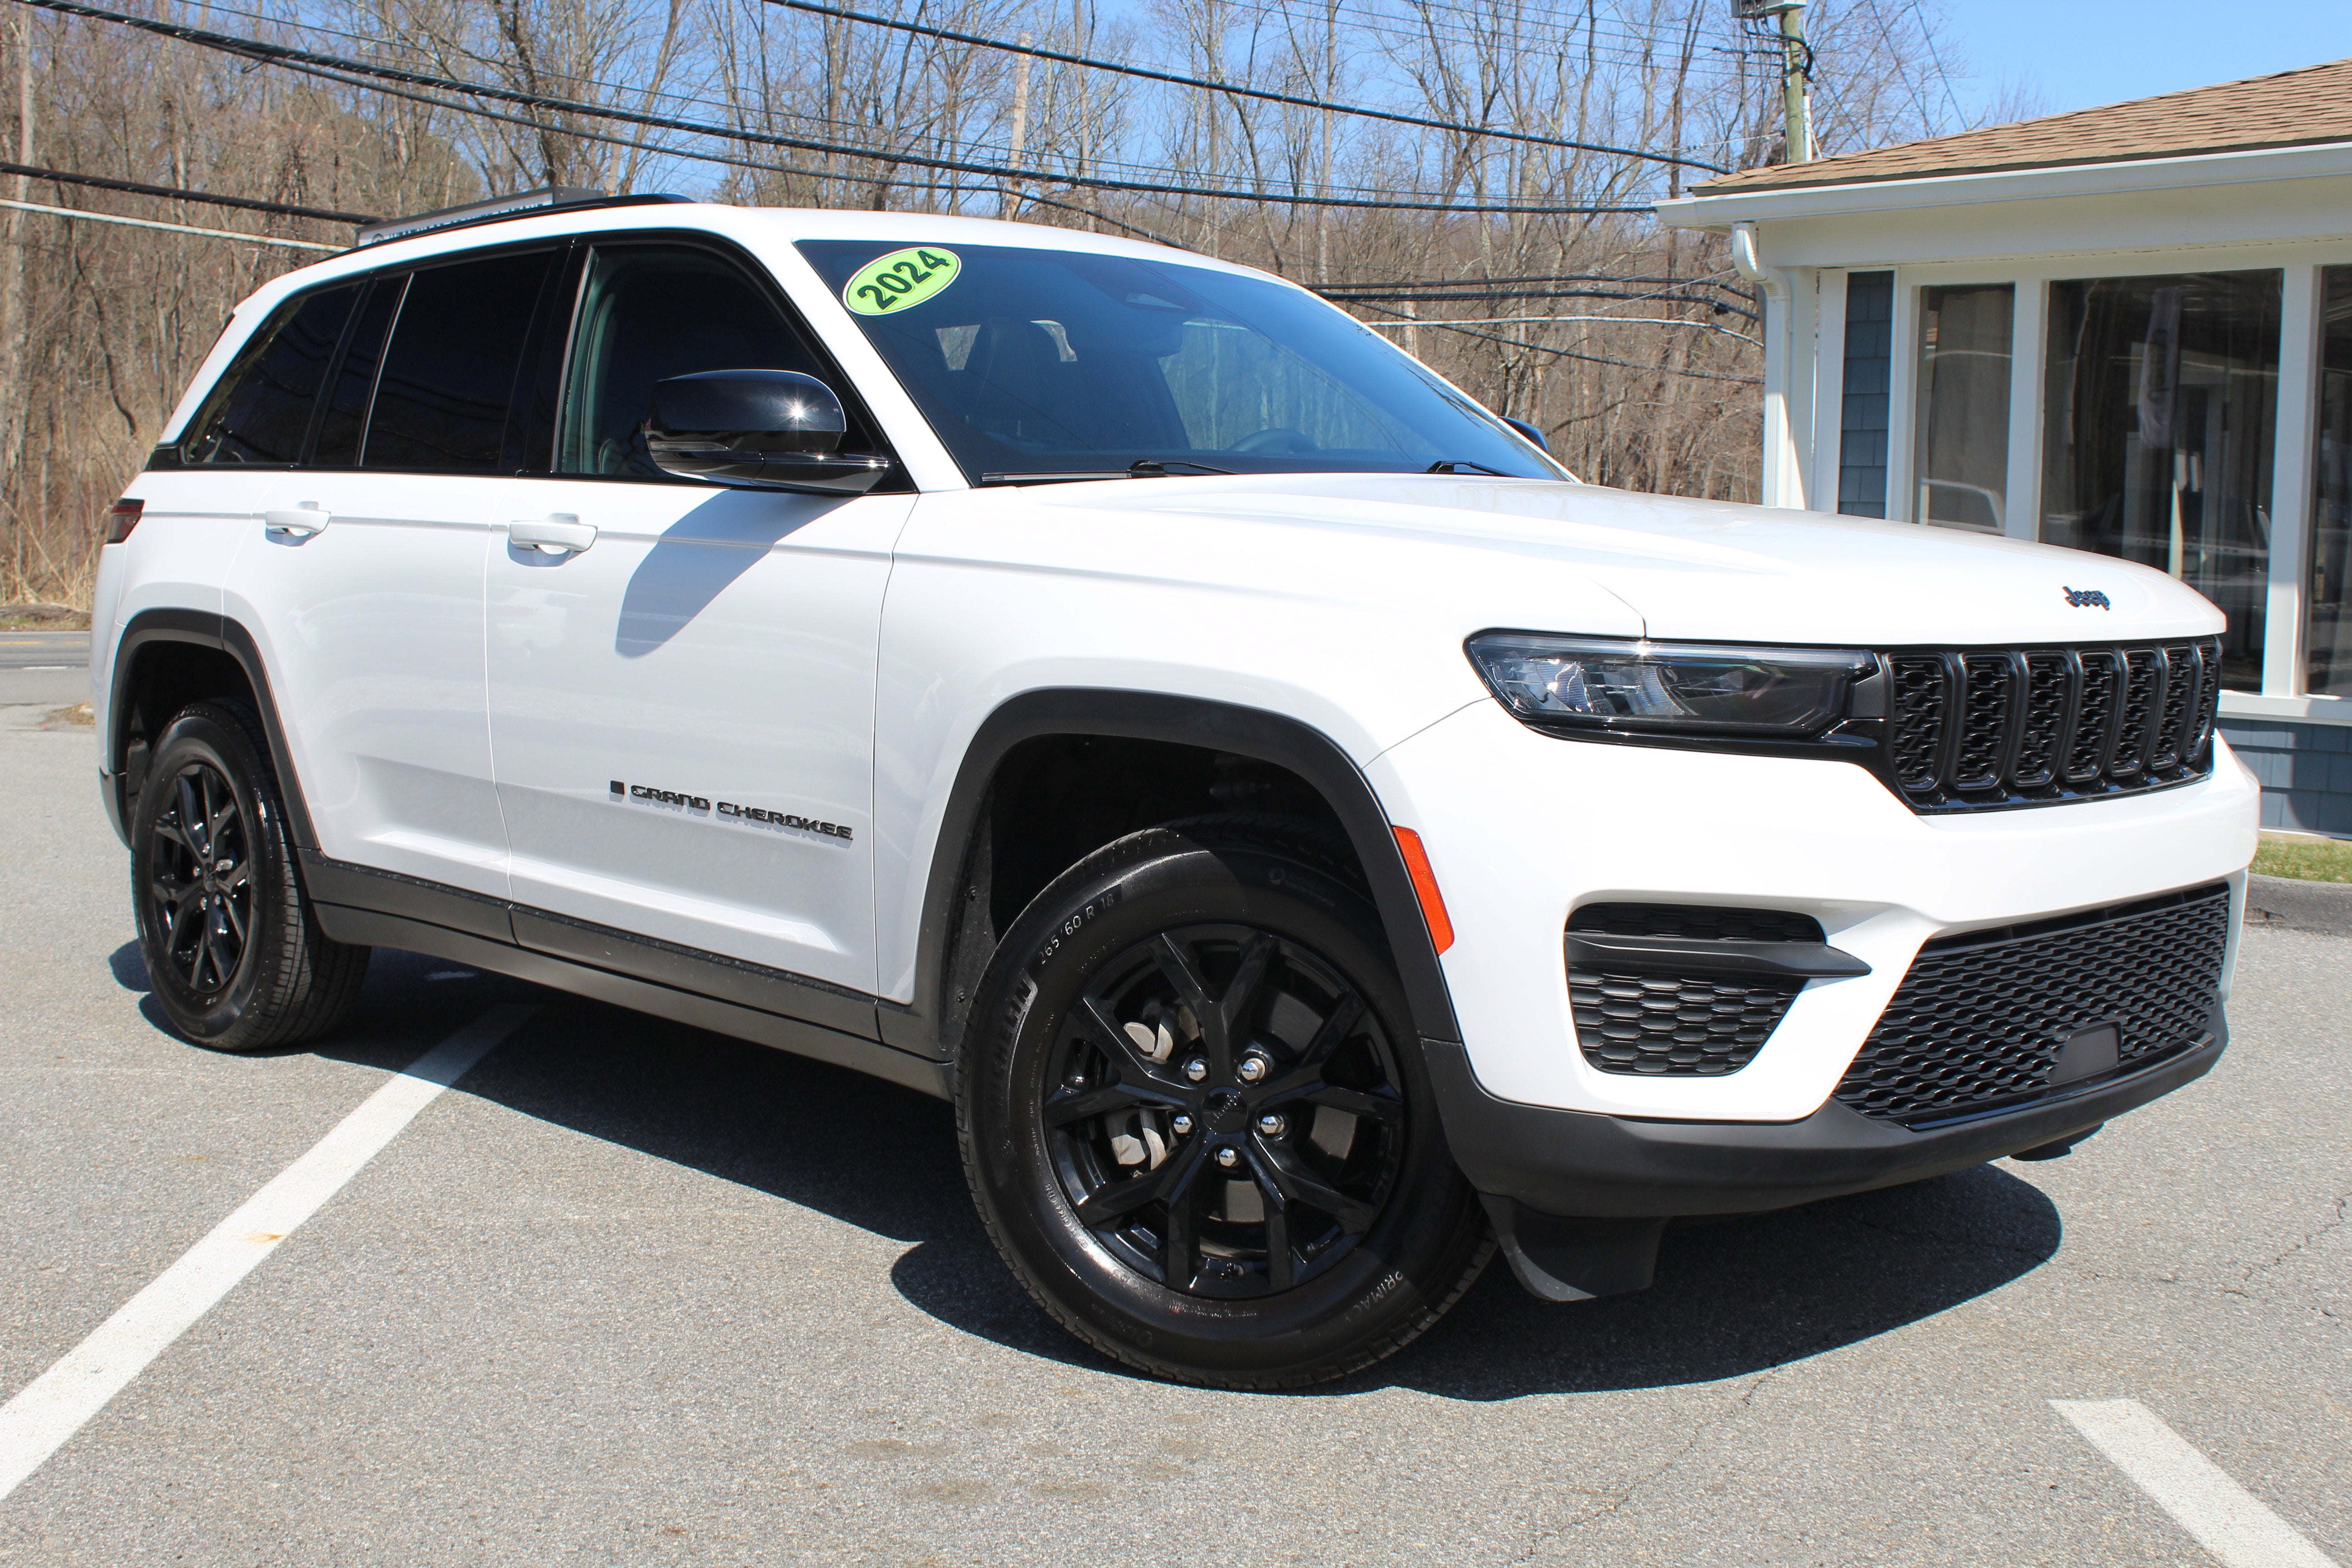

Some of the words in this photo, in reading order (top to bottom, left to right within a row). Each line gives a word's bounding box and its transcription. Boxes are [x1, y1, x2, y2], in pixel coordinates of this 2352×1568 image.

[857, 250, 951, 310] 2024
[2062, 586, 2110, 611] Jeep
[631, 784, 710, 810] GRAND
[717, 801, 853, 840] CHEROKEE
